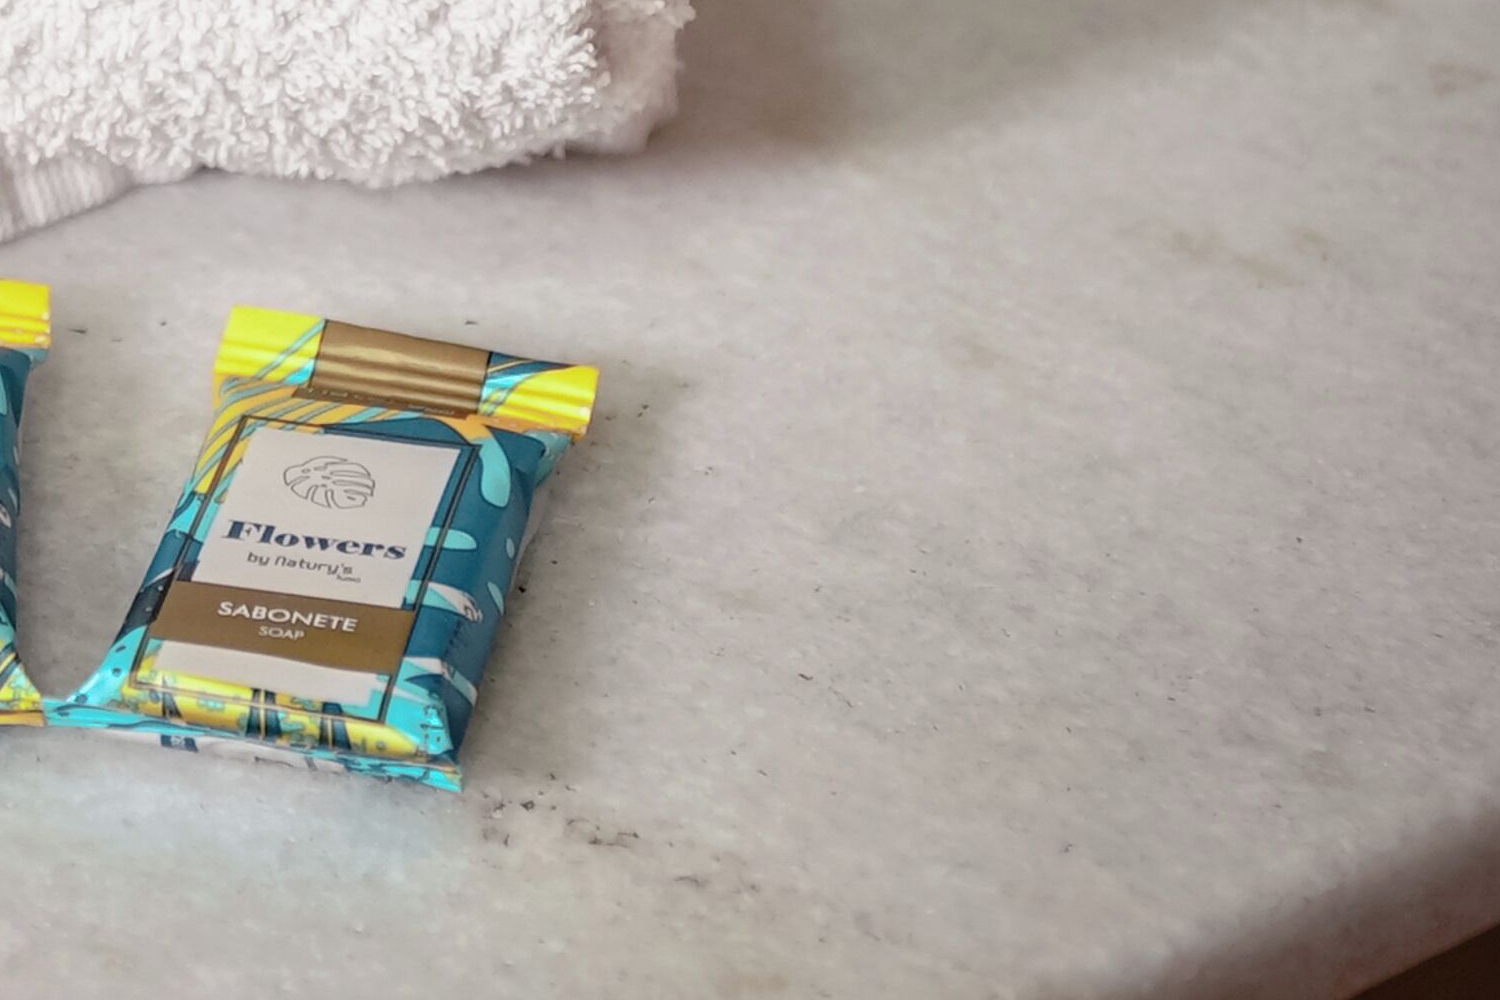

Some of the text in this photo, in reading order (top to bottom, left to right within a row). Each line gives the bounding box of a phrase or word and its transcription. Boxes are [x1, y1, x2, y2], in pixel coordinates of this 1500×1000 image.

[221, 519, 408, 560] Flowers
[247, 552, 270, 567] by
[217, 601, 358, 632] SABONETE
[258, 626, 305, 640] SOAP
